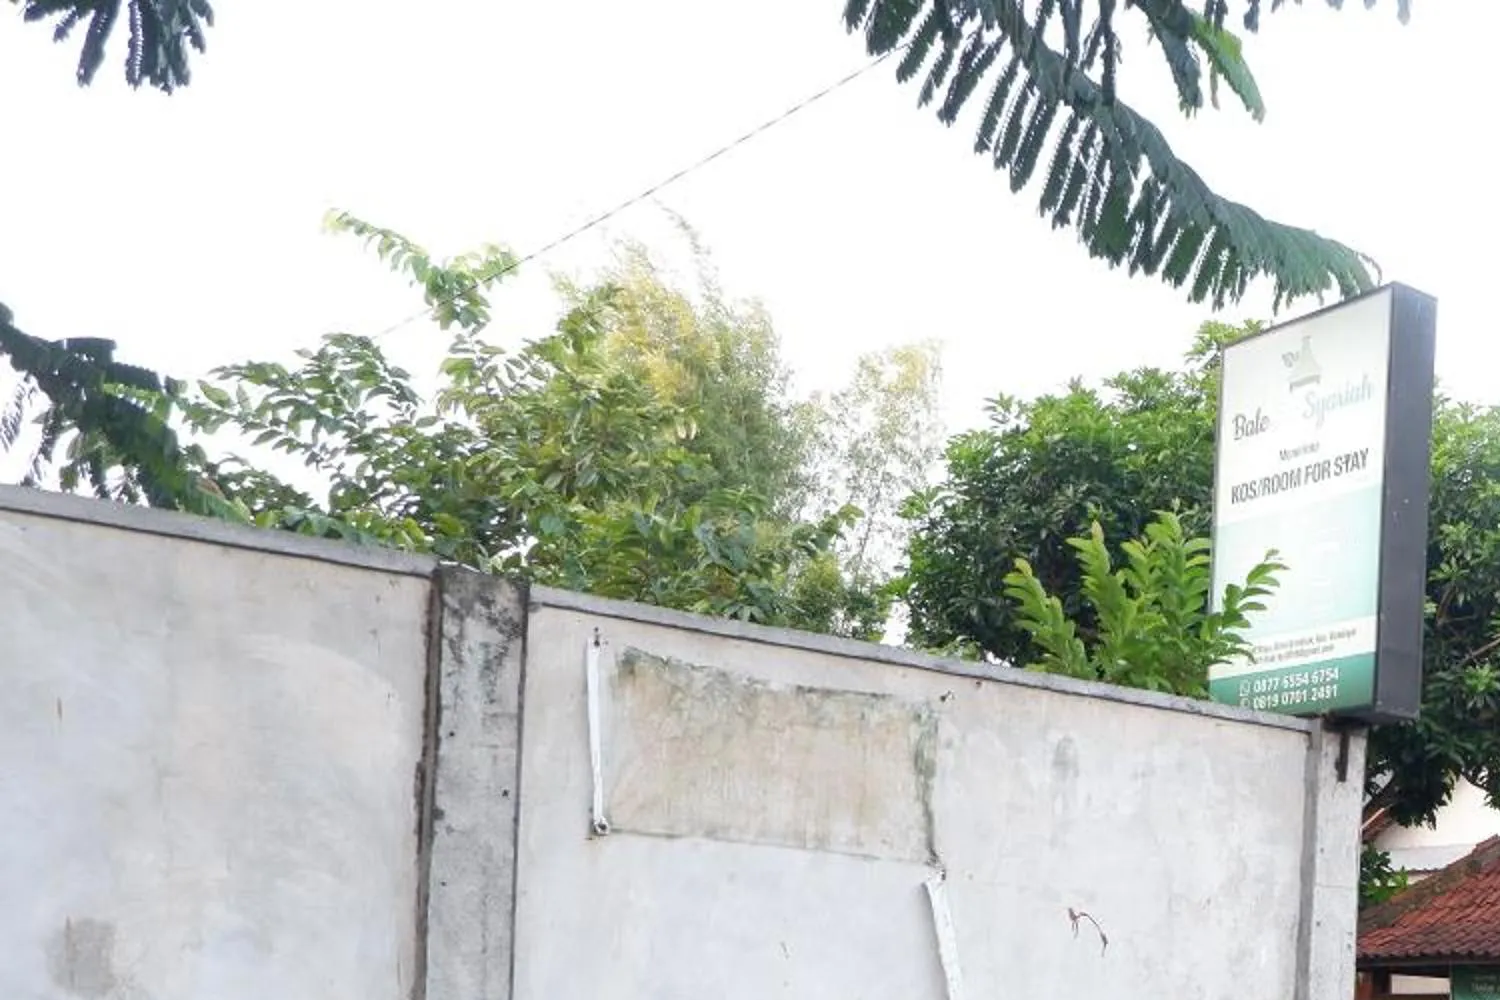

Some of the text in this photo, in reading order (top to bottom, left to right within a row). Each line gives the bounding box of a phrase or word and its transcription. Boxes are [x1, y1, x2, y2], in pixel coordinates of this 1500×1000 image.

[1231, 467, 1302, 505] KOS/ROOM
[1304, 459, 1332, 486] FOR
[1333, 447, 1369, 477] STAY
